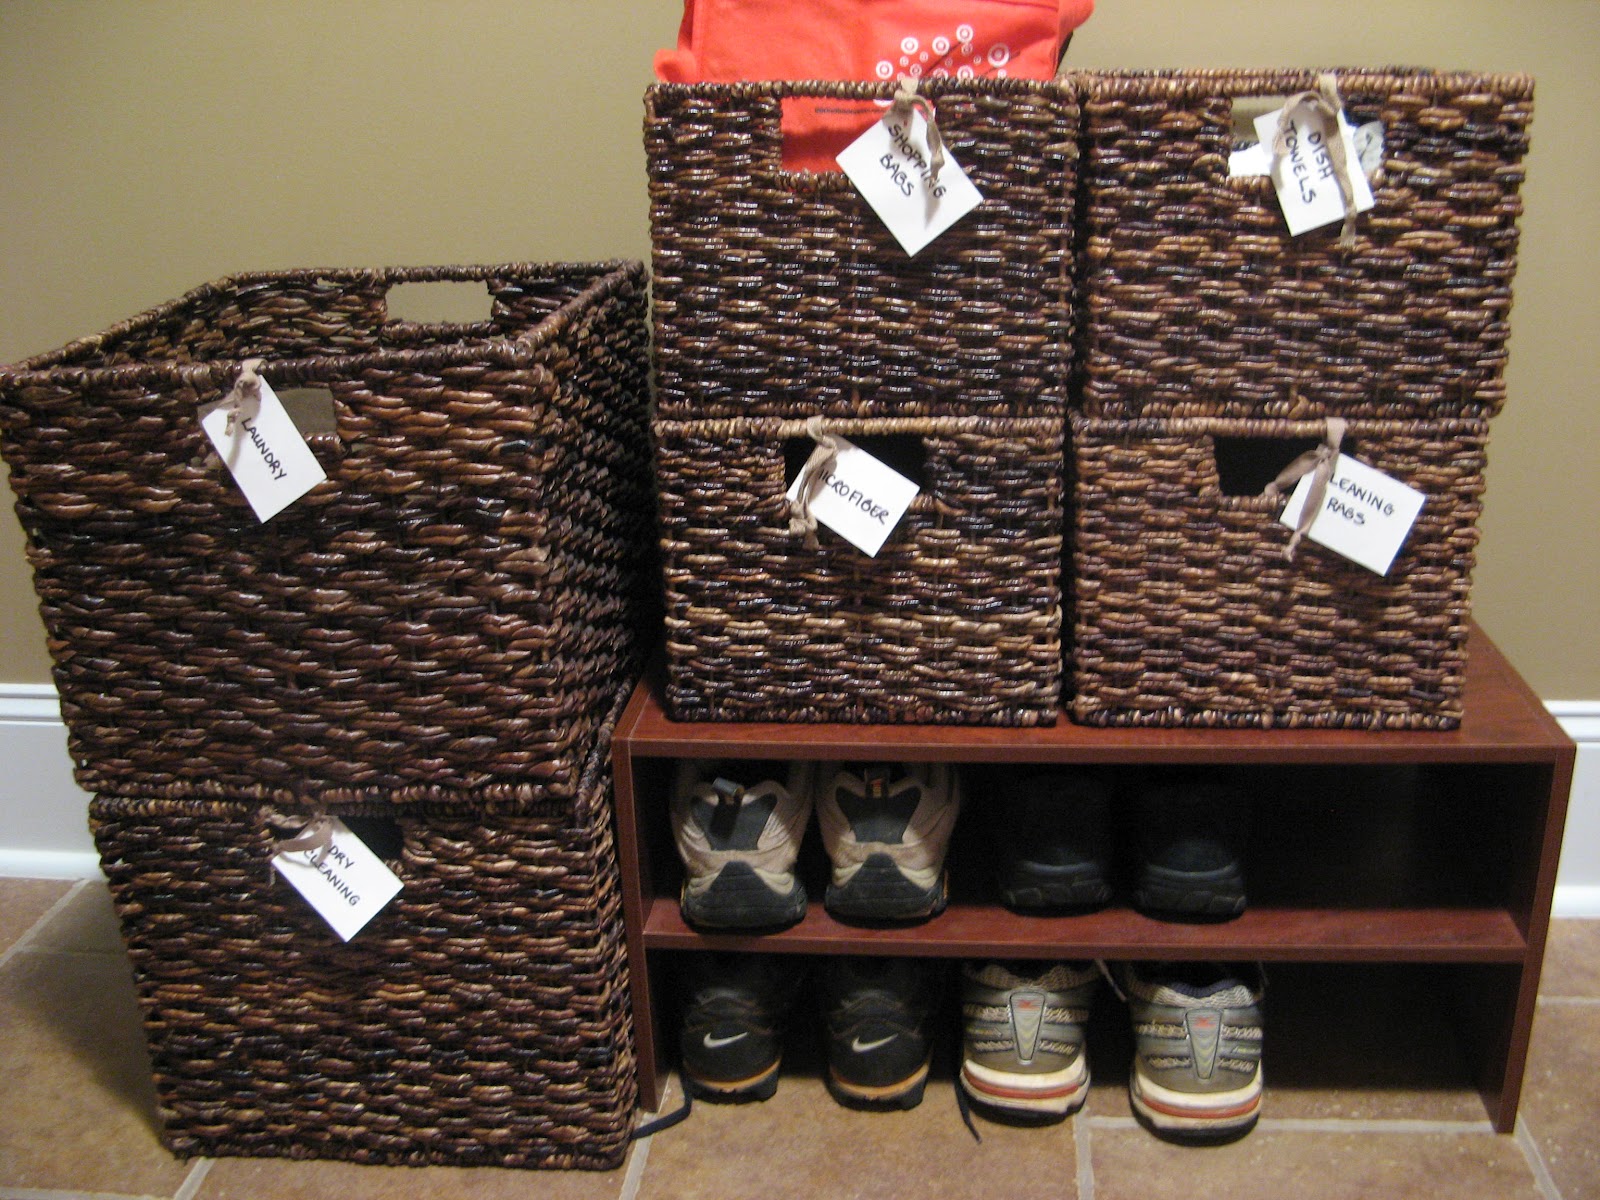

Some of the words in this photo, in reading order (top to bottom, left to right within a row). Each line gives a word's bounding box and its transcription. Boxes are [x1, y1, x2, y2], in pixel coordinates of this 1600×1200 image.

[880, 153, 915, 197] BAGS
[1283, 119, 1316, 203] TOWELS
[1307, 131, 1336, 180] DISH
[241, 418, 287, 481] LAUNDRY
[1327, 497, 1365, 525] RAGS
[1329, 474, 1395, 516] LEANING
[327, 845, 355, 869] DRY
